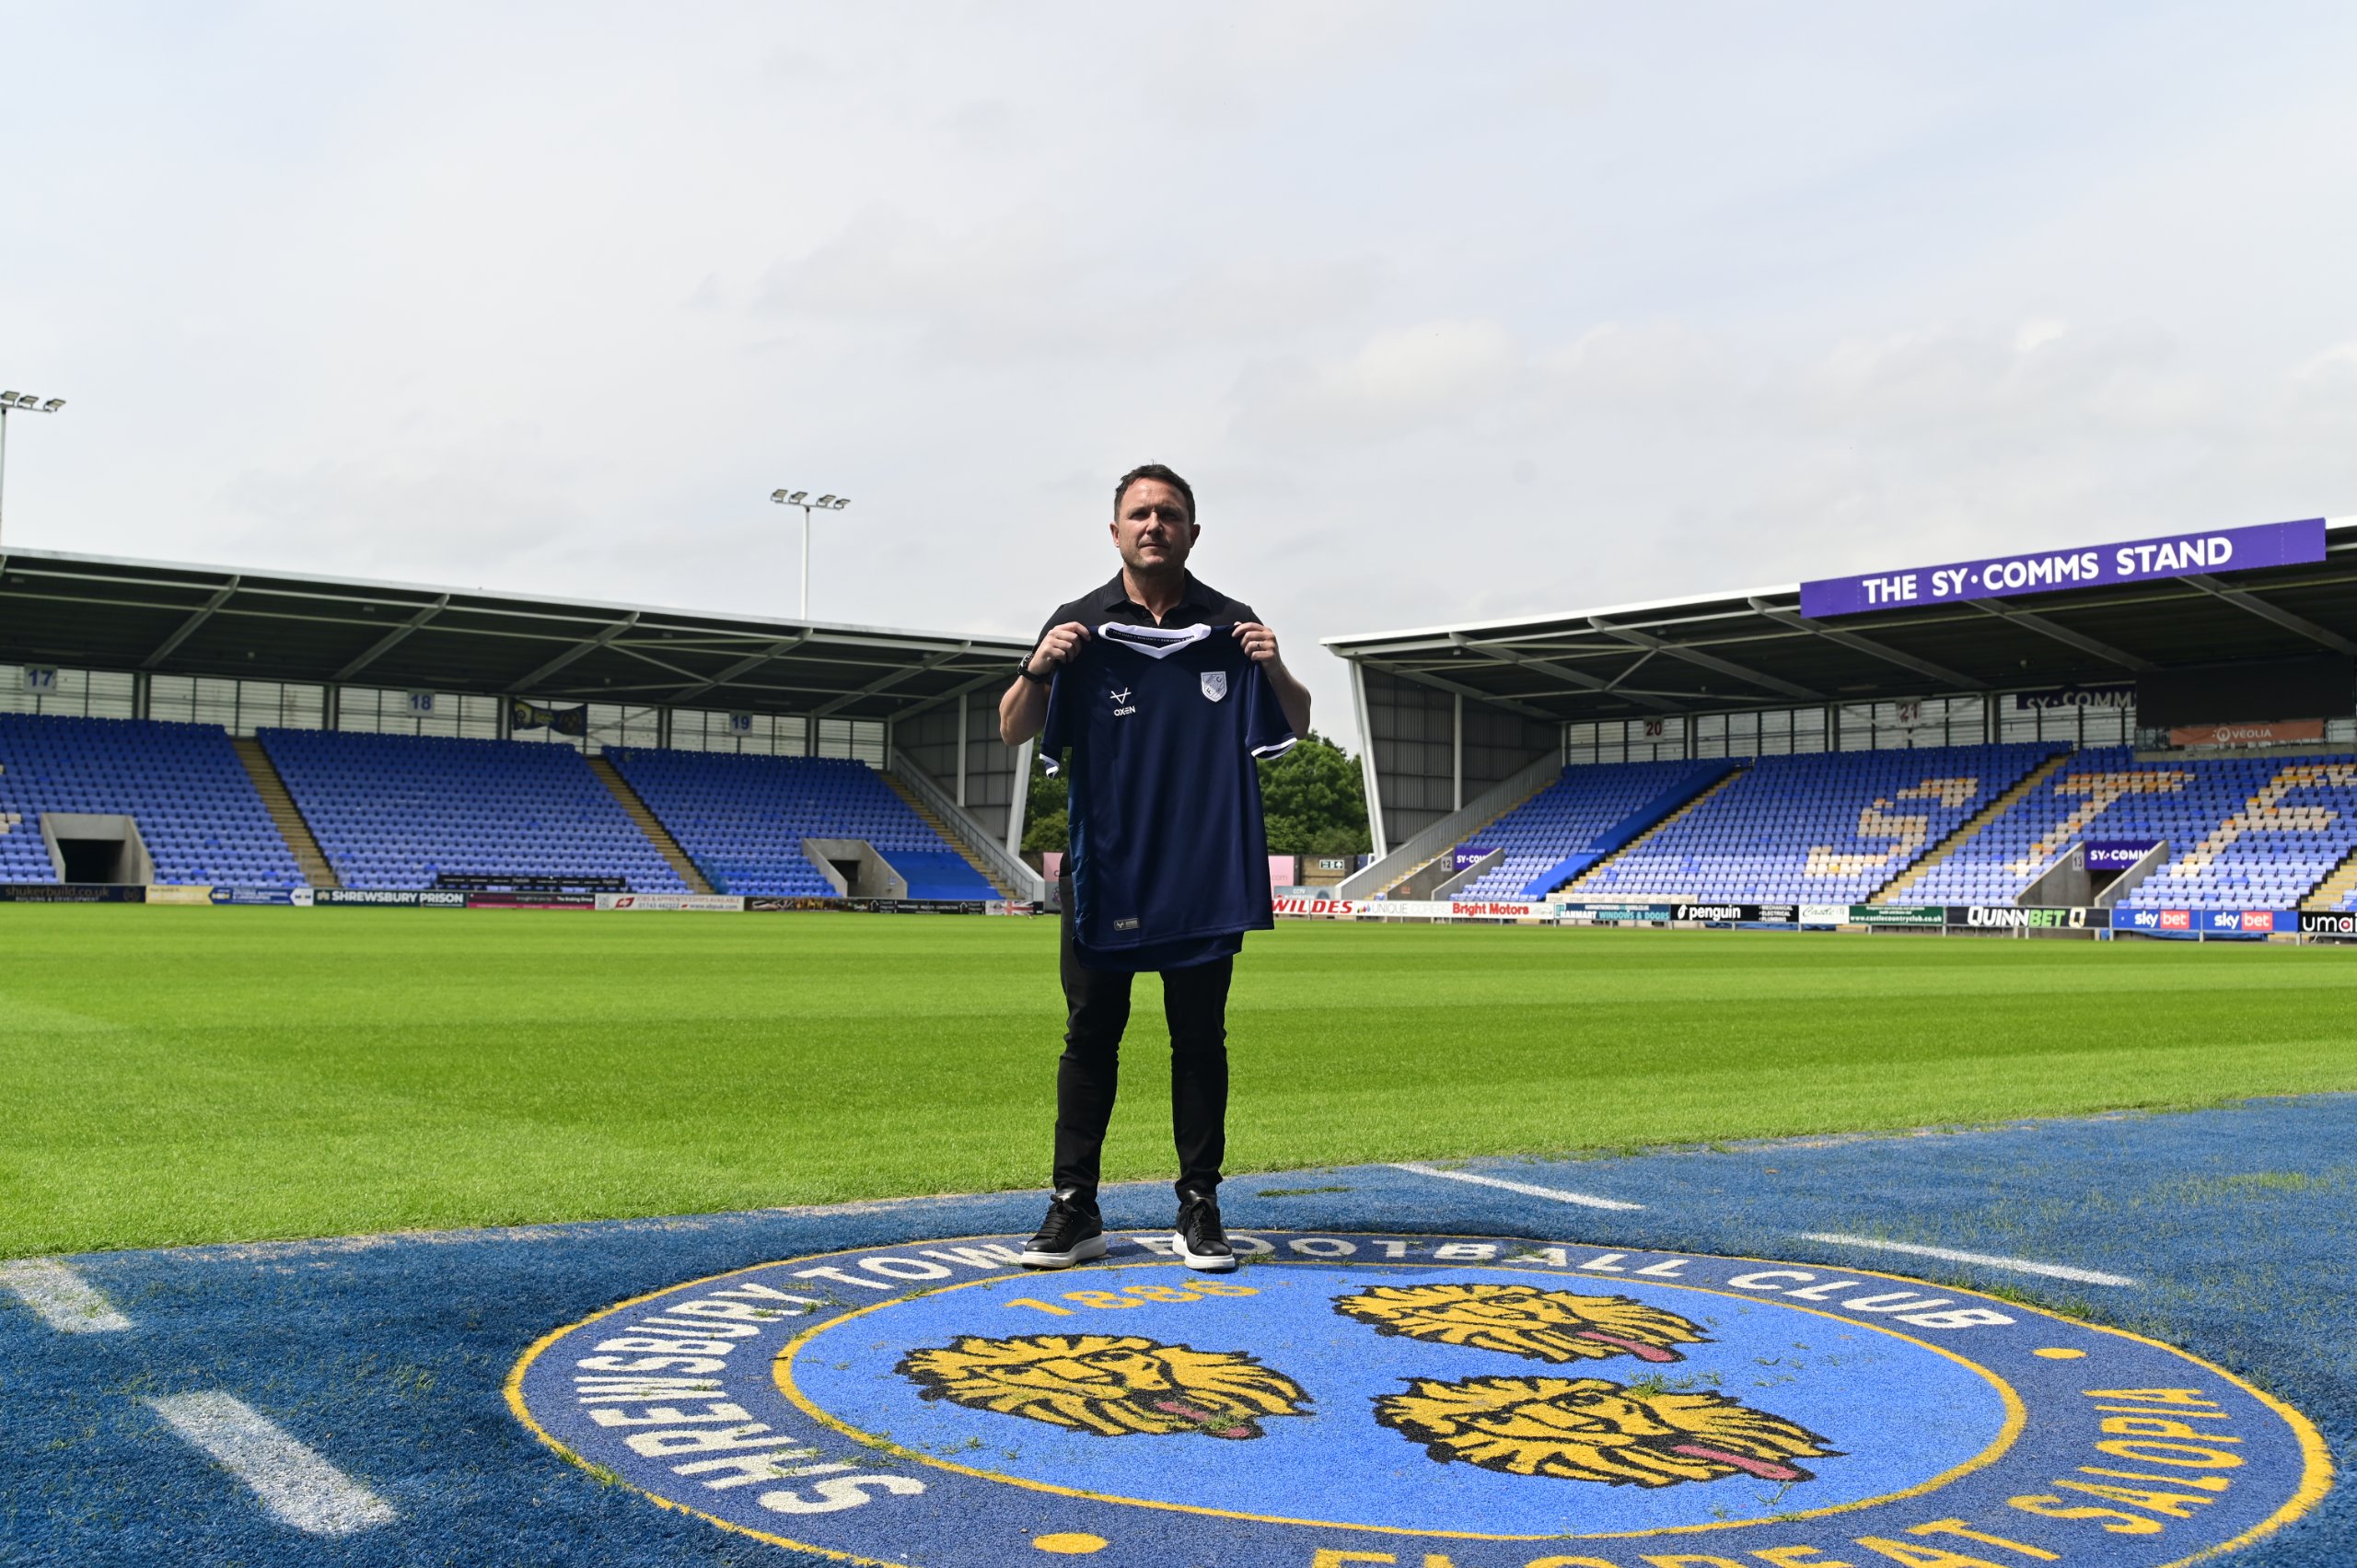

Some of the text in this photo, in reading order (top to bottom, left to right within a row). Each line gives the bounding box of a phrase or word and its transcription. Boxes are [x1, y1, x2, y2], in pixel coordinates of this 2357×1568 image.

[1862, 575, 1918, 604] THE
[2116, 537, 2234, 575] STAND
[29, 668, 54, 687] 17
[411, 693, 432, 712] 18
[2026, 691, 2136, 709] SY·COMM
[1114, 705, 1136, 716] OXEN
[733, 714, 749, 730] 19
[1646, 721, 1662, 737] 20
[1442, 860, 1452, 869] 12
[6, 886, 110, 897] shukerbuild.co.uk
[331, 890, 417, 903] SHREWSBURY
[420, 892, 463, 903] PRISON
[1272, 900, 1353, 914] WILDES
[1372, 903, 1408, 914] UNIQUE
[1453, 902, 1529, 917] Bright Motors
[1689, 904, 1741, 921] penguin
[1599, 911, 1634, 919] WINDOWS
[1644, 912, 1669, 920] DOORS
[2133, 910, 2187, 928] sky bet
[2213, 912, 2270, 930] sky bet
[1004, 1279, 1261, 1317] 1886
[573, 1282, 927, 1516] SHREWSBURY
[792, 1241, 1040, 1289] TOW
[1727, 1270, 2017, 1329] CLUB
[2007, 1388, 2247, 1535] SALOPIA
